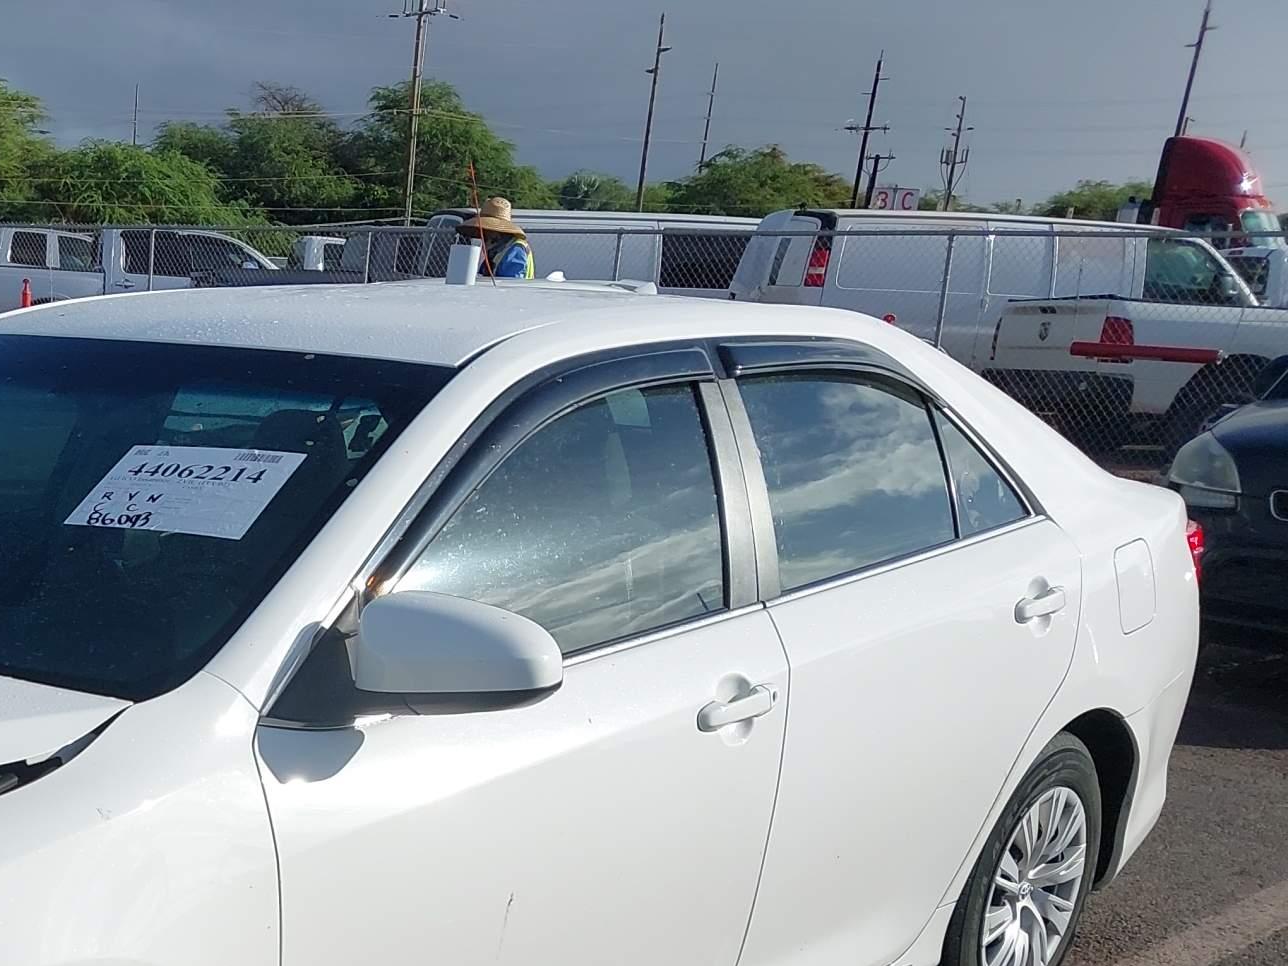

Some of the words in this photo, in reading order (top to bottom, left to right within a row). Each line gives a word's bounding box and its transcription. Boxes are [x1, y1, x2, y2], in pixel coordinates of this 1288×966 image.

[901, 191, 914, 210] C
[128, 462, 268, 484] 44062214
[101, 491, 114, 501] R
[127, 490, 140, 502] Y
[146, 493, 164, 503] N
